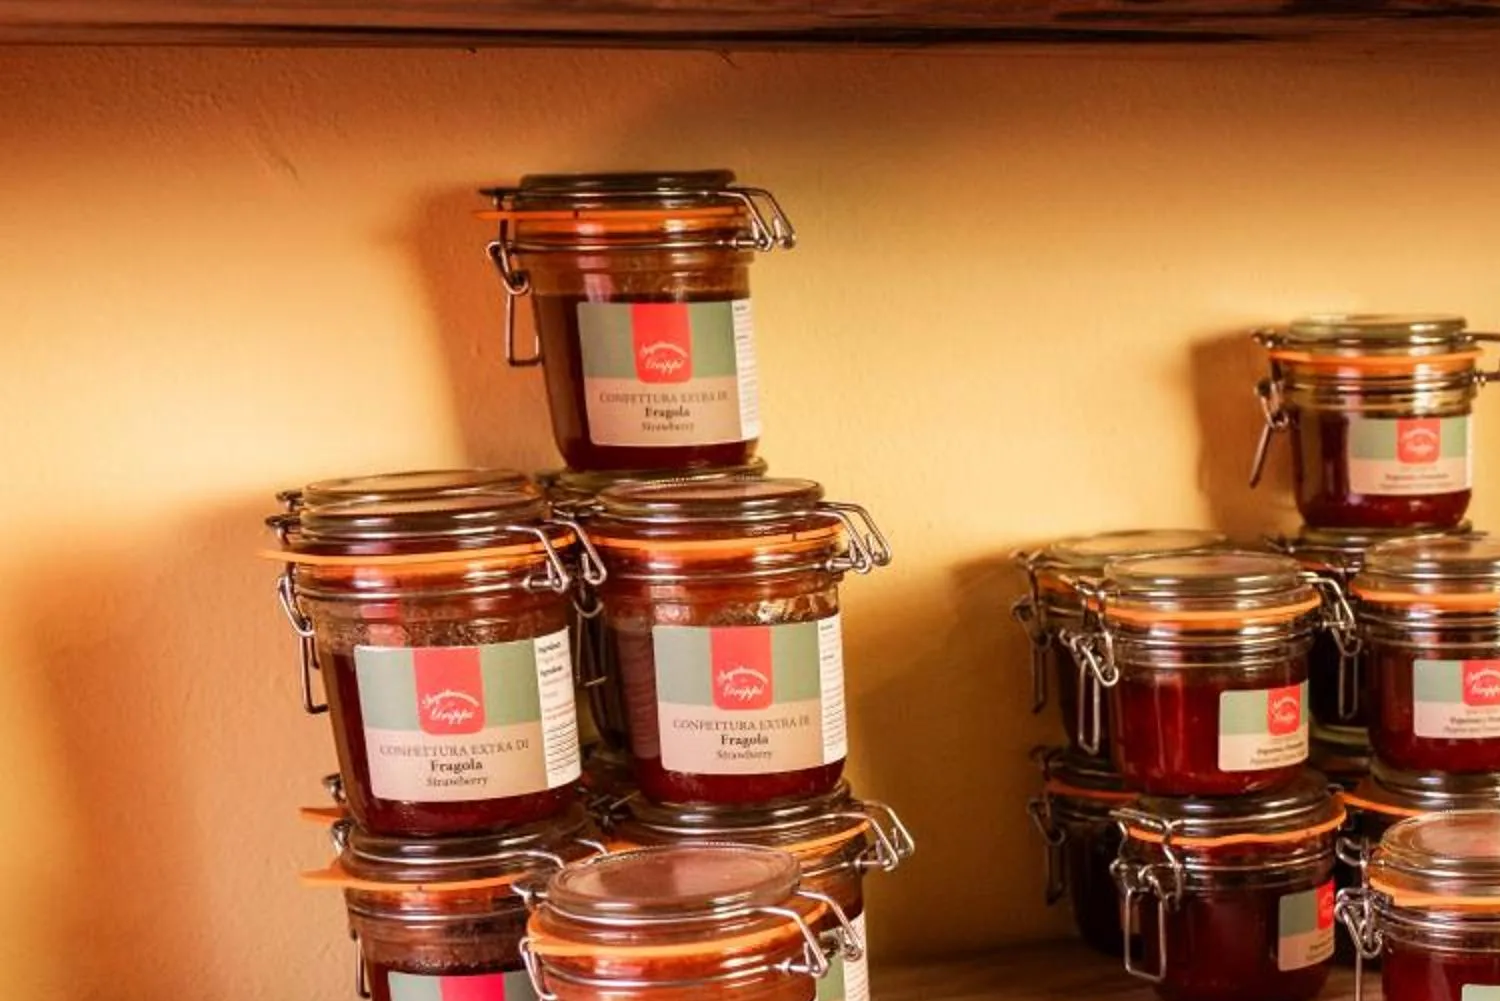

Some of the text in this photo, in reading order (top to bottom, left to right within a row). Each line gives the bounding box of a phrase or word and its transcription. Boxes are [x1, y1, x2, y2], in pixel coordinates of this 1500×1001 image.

[644, 405, 691, 419] Fragola
[672, 718, 758, 731] CONFETTURA
[759, 717, 798, 731] EXTRA
[379, 738, 530, 757] CONFETTURA EXTRA DI
[720, 733, 770, 748] Fragola
[430, 757, 484, 773] Fragola
[425, 775, 489, 788] Strawberry
